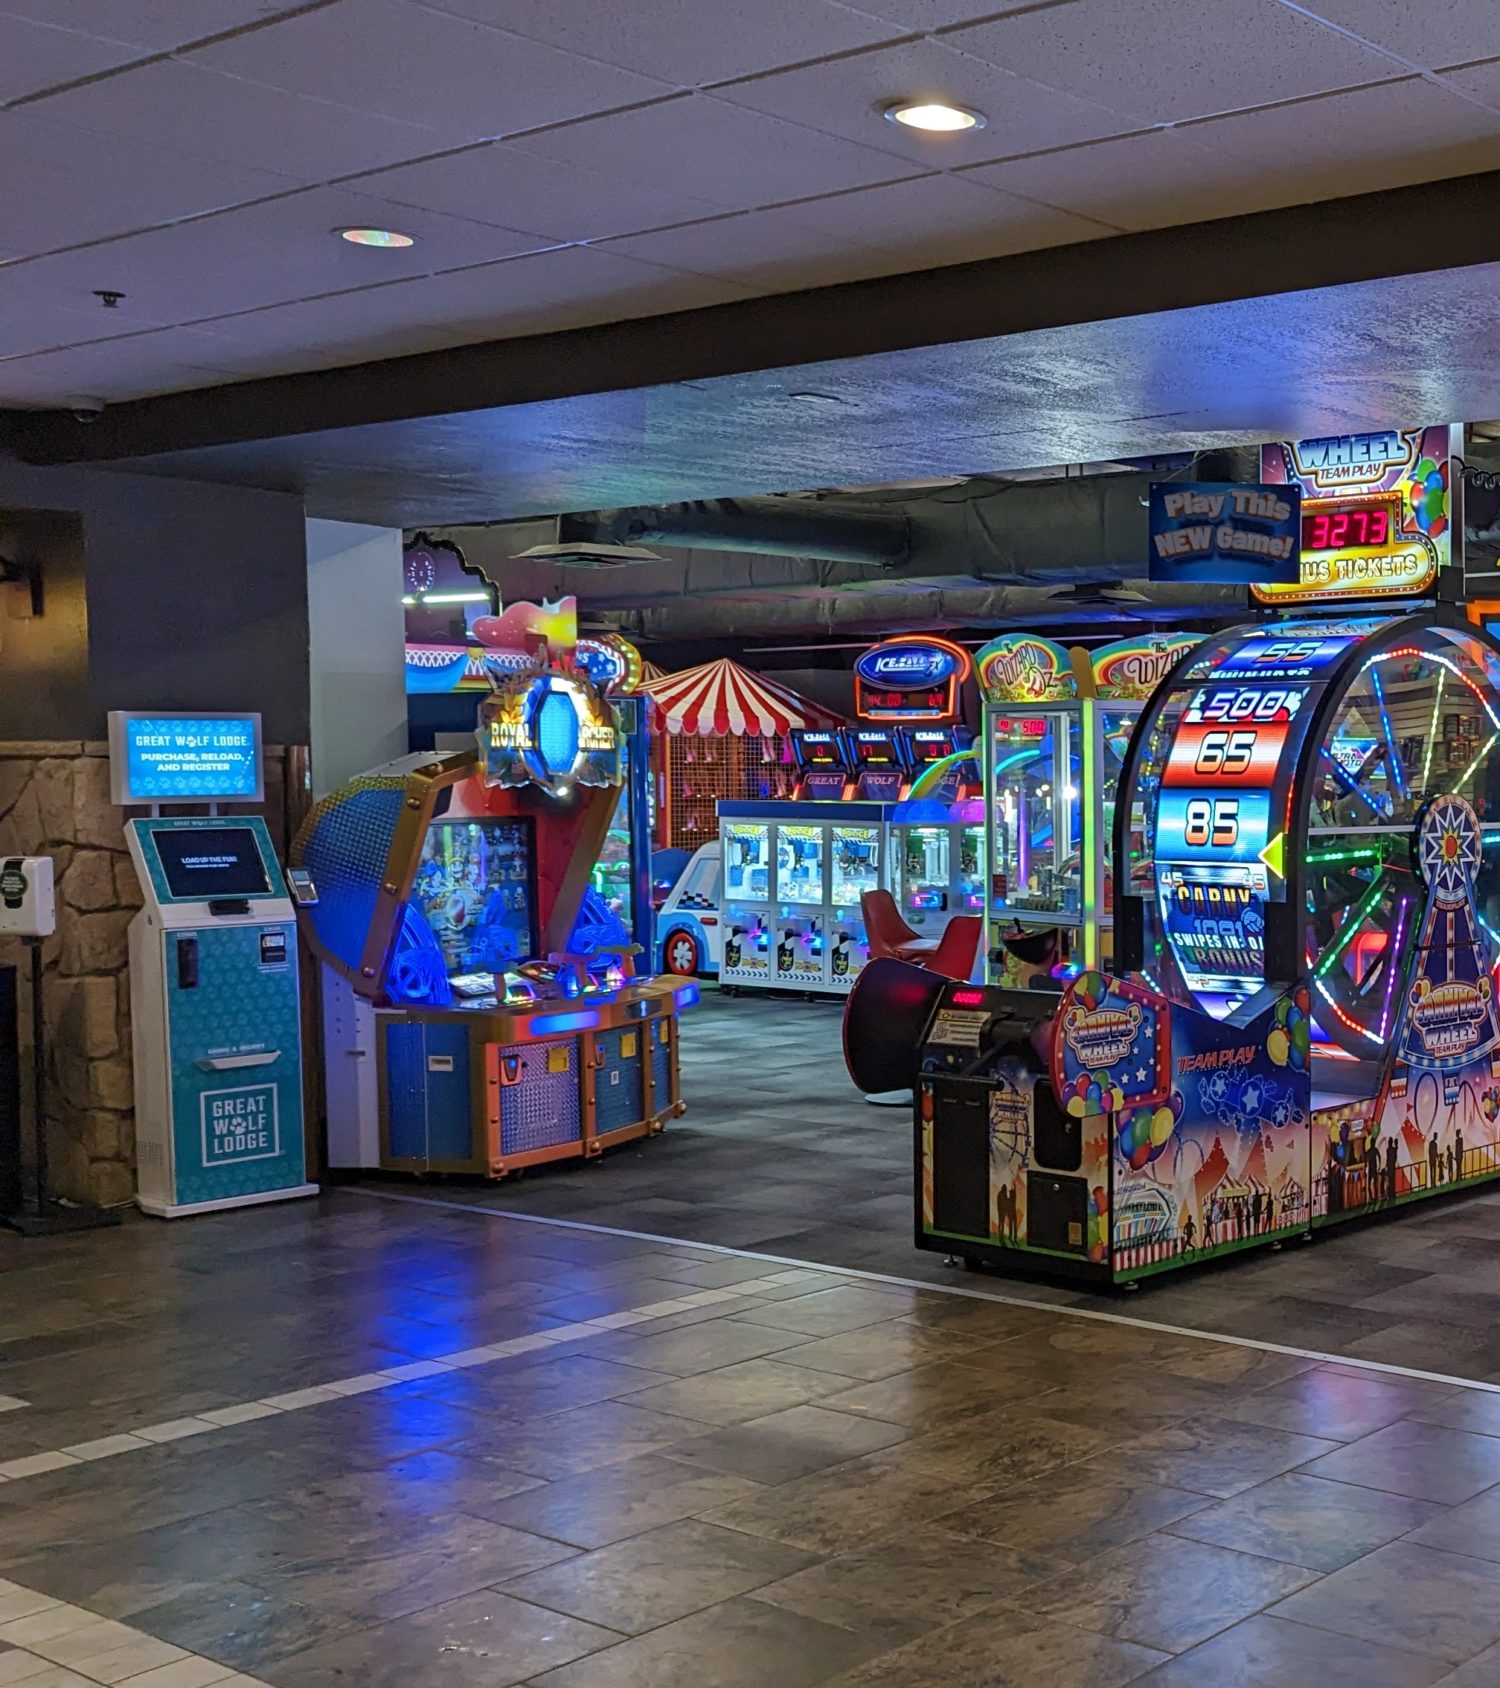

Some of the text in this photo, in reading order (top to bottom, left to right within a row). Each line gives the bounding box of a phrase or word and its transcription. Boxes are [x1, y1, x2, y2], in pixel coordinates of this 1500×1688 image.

[1298, 431, 1405, 468] WHEEL
[1320, 463, 1381, 480] TEAM PLAY
[1164, 490, 1292, 521] Play This
[1312, 511, 1388, 548] 3273
[1154, 525, 1294, 559] NEW Game!
[1336, 554, 1417, 579] TICKETS
[997, 643, 1036, 686] WIZARD
[1253, 641, 1323, 664] 55
[1202, 690, 1291, 719] 500
[136, 736, 171, 747] GREAT
[213, 736, 248, 747] LODGE
[491, 723, 532, 747] ROYAL
[141, 753, 245, 762] PURCHASE, RELOAD,
[1194, 732, 1258, 775] 65
[157, 763, 230, 771] AND REGISTER
[807, 777, 840, 785] GREAT
[866, 777, 894, 785] WOLF
[1185, 799, 1239, 846] 85
[1174, 932, 1222, 948] SWIPES
[1424, 1022, 1477, 1047] WHEEL
[1080, 1040, 1127, 1058] WHEEL
[1177, 1045, 1256, 1073] TEAM PLAY
[212, 1095, 266, 1117] GREAT
[214, 1132, 268, 1154] LODGE
